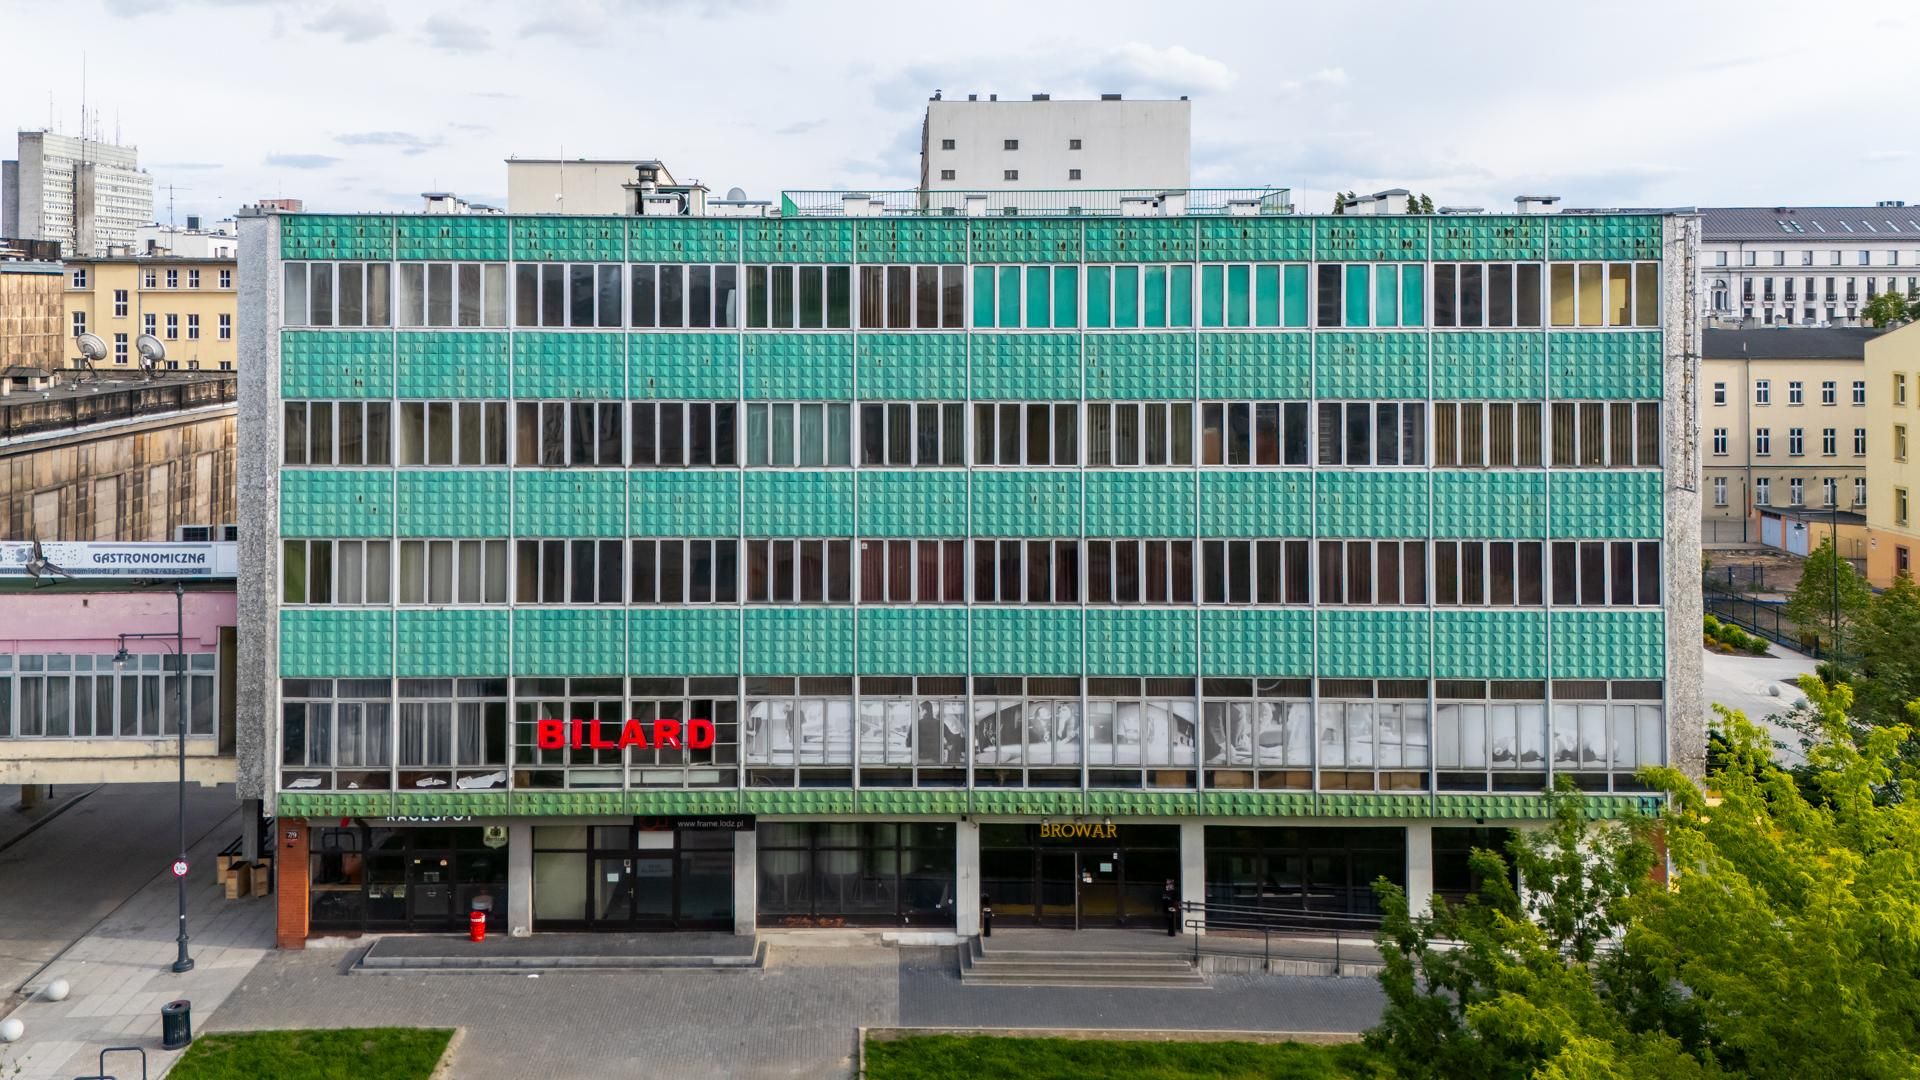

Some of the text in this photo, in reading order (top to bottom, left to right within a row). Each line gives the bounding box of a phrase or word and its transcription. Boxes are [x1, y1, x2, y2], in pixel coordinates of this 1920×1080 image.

[93, 552, 206, 565] GASTRONOMICZNA
[537, 719, 716, 750] BILARD
[677, 820, 744, 829] www.frame.lodz.pl
[1040, 823, 1118, 838] BROWAR
